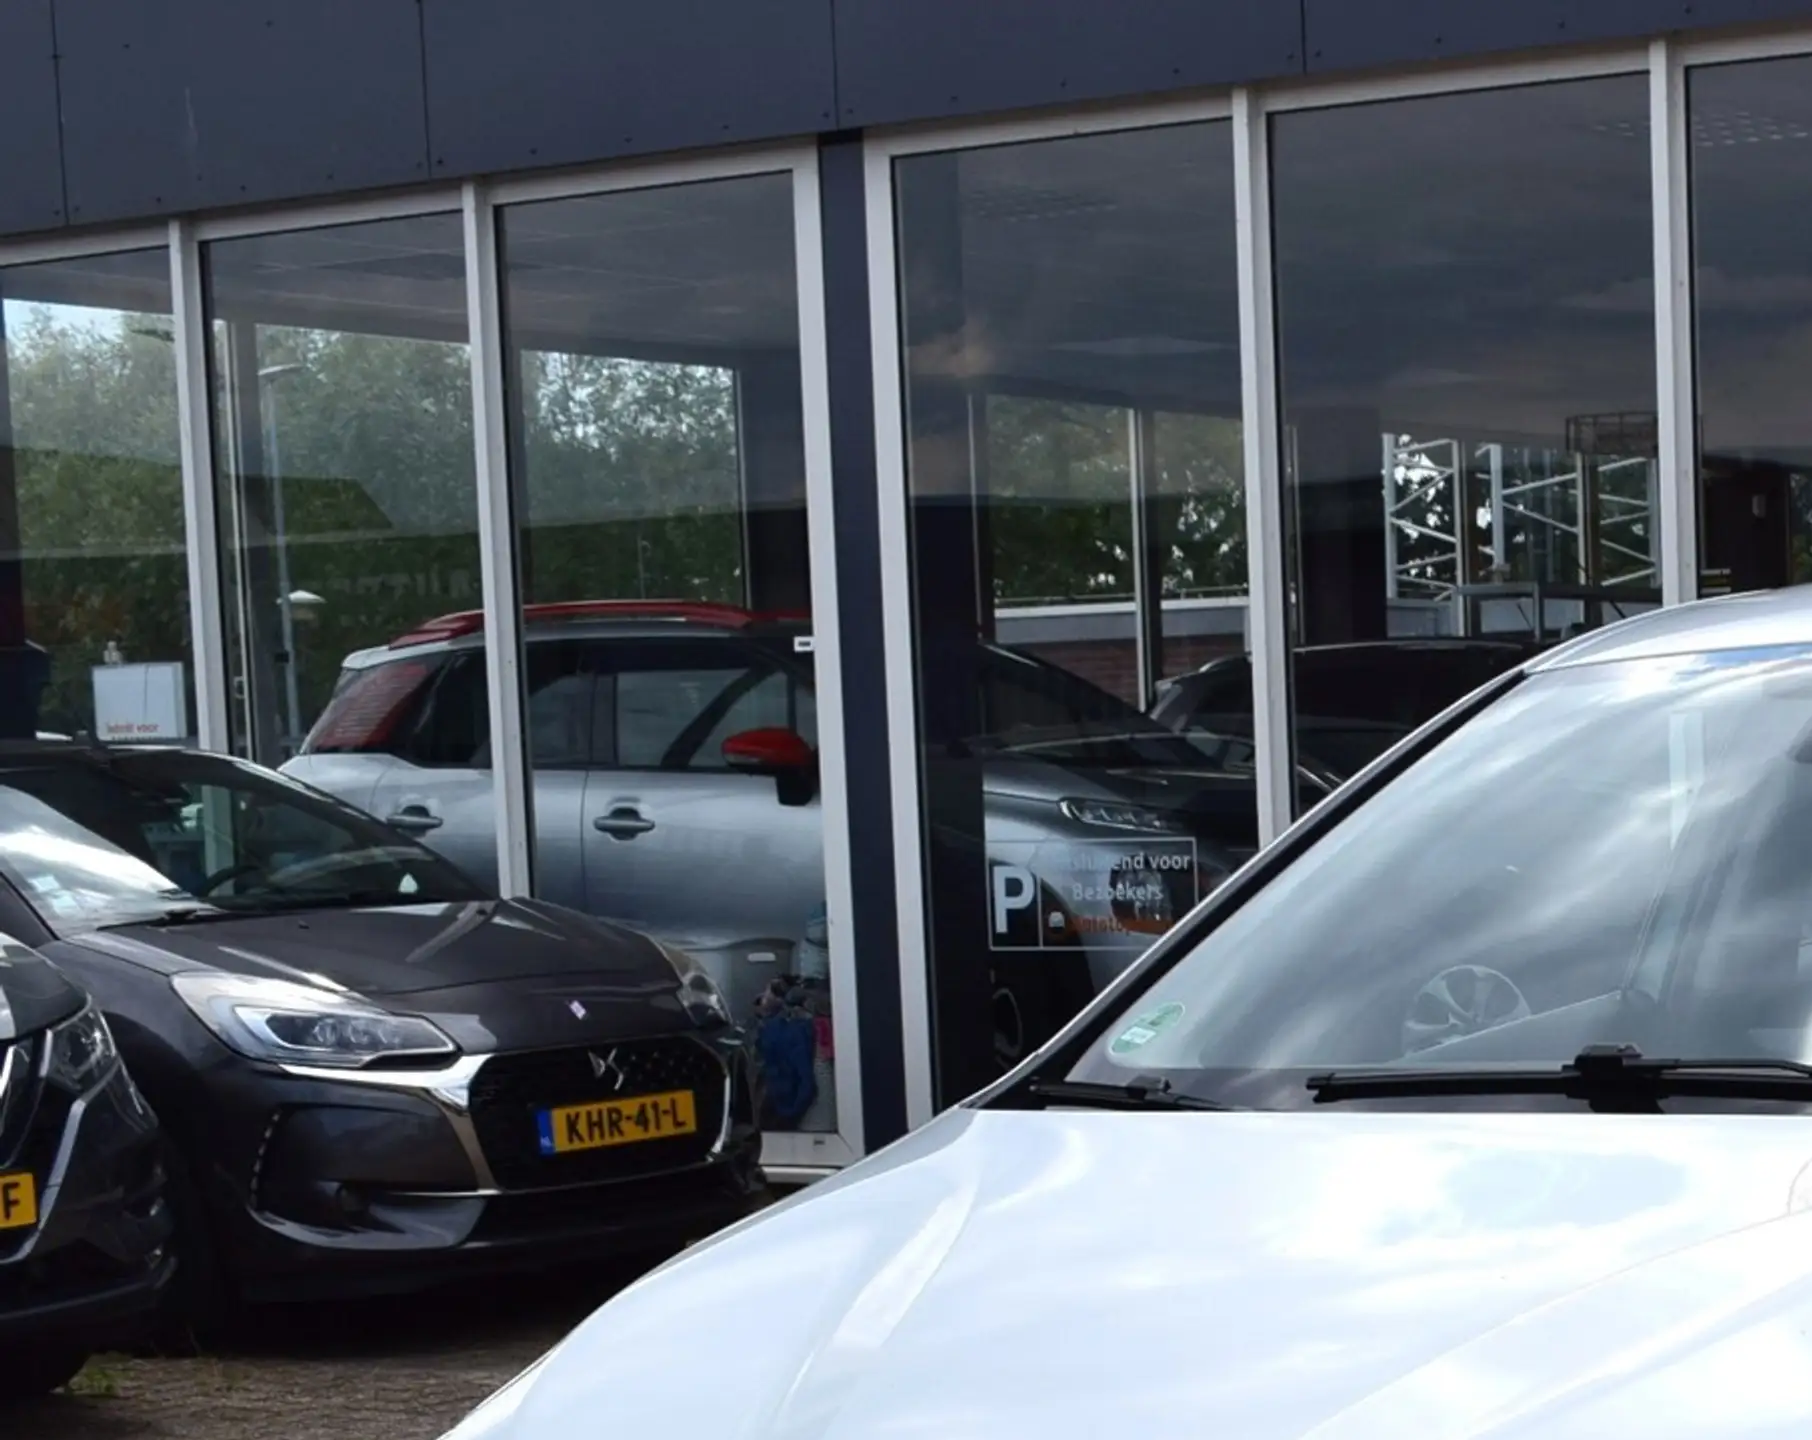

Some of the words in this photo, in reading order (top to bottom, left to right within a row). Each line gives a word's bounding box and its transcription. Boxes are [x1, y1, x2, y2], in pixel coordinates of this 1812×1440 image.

[1150, 854, 1191, 870] voor
[993, 865, 1035, 934] P
[1072, 881, 1164, 901] Bezoekers
[565, 1097, 687, 1145] KHR-41-L
